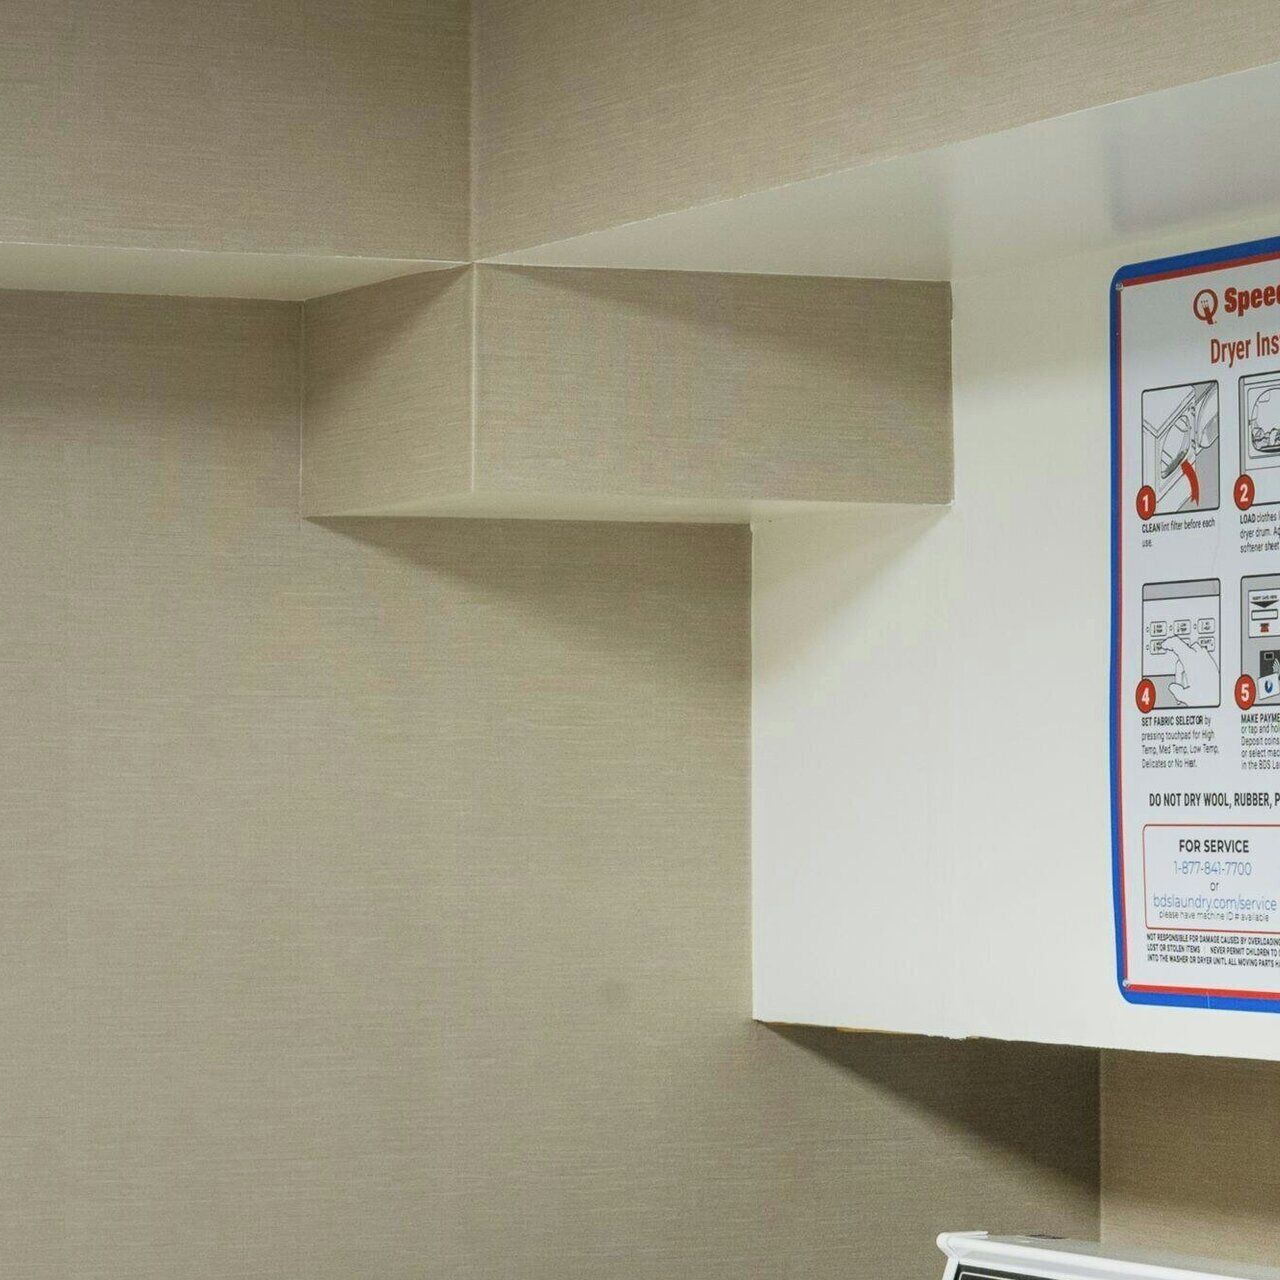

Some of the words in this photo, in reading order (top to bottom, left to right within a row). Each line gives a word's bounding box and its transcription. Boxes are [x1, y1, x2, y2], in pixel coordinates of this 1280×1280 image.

[1210, 336, 1251, 368] Dryer
[1240, 484, 1248, 502] 2
[1142, 494, 1150, 512] 1
[1142, 523, 1160, 534] CLEAN
[1161, 522, 1170, 532] lint
[1171, 521, 1182, 530] filter
[1184, 519, 1201, 530] before
[1202, 518, 1216, 528] each
[1142, 688, 1150, 705] 4
[1241, 684, 1250, 702] 5
[1142, 717, 1153, 726] SET
[1154, 716, 1174, 726] FABRIC
[1176, 716, 1204, 726] SELECTOR
[1204, 716, 1212, 726] by
[1240, 713, 1258, 723] MAKE
[1148, 793, 1162, 806] DO
[1164, 793, 1183, 806] NOT
[1184, 793, 1202, 806] DRY
[1204, 793, 1232, 808] WOOL,
[1234, 792, 1272, 808] RUBBER,
[1178, 840, 1201, 853] FOR
[1204, 840, 1250, 853] SERVICE
[1174, 860, 1252, 876] 1-877-841-7700
[1210, 881, 1219, 891] or
